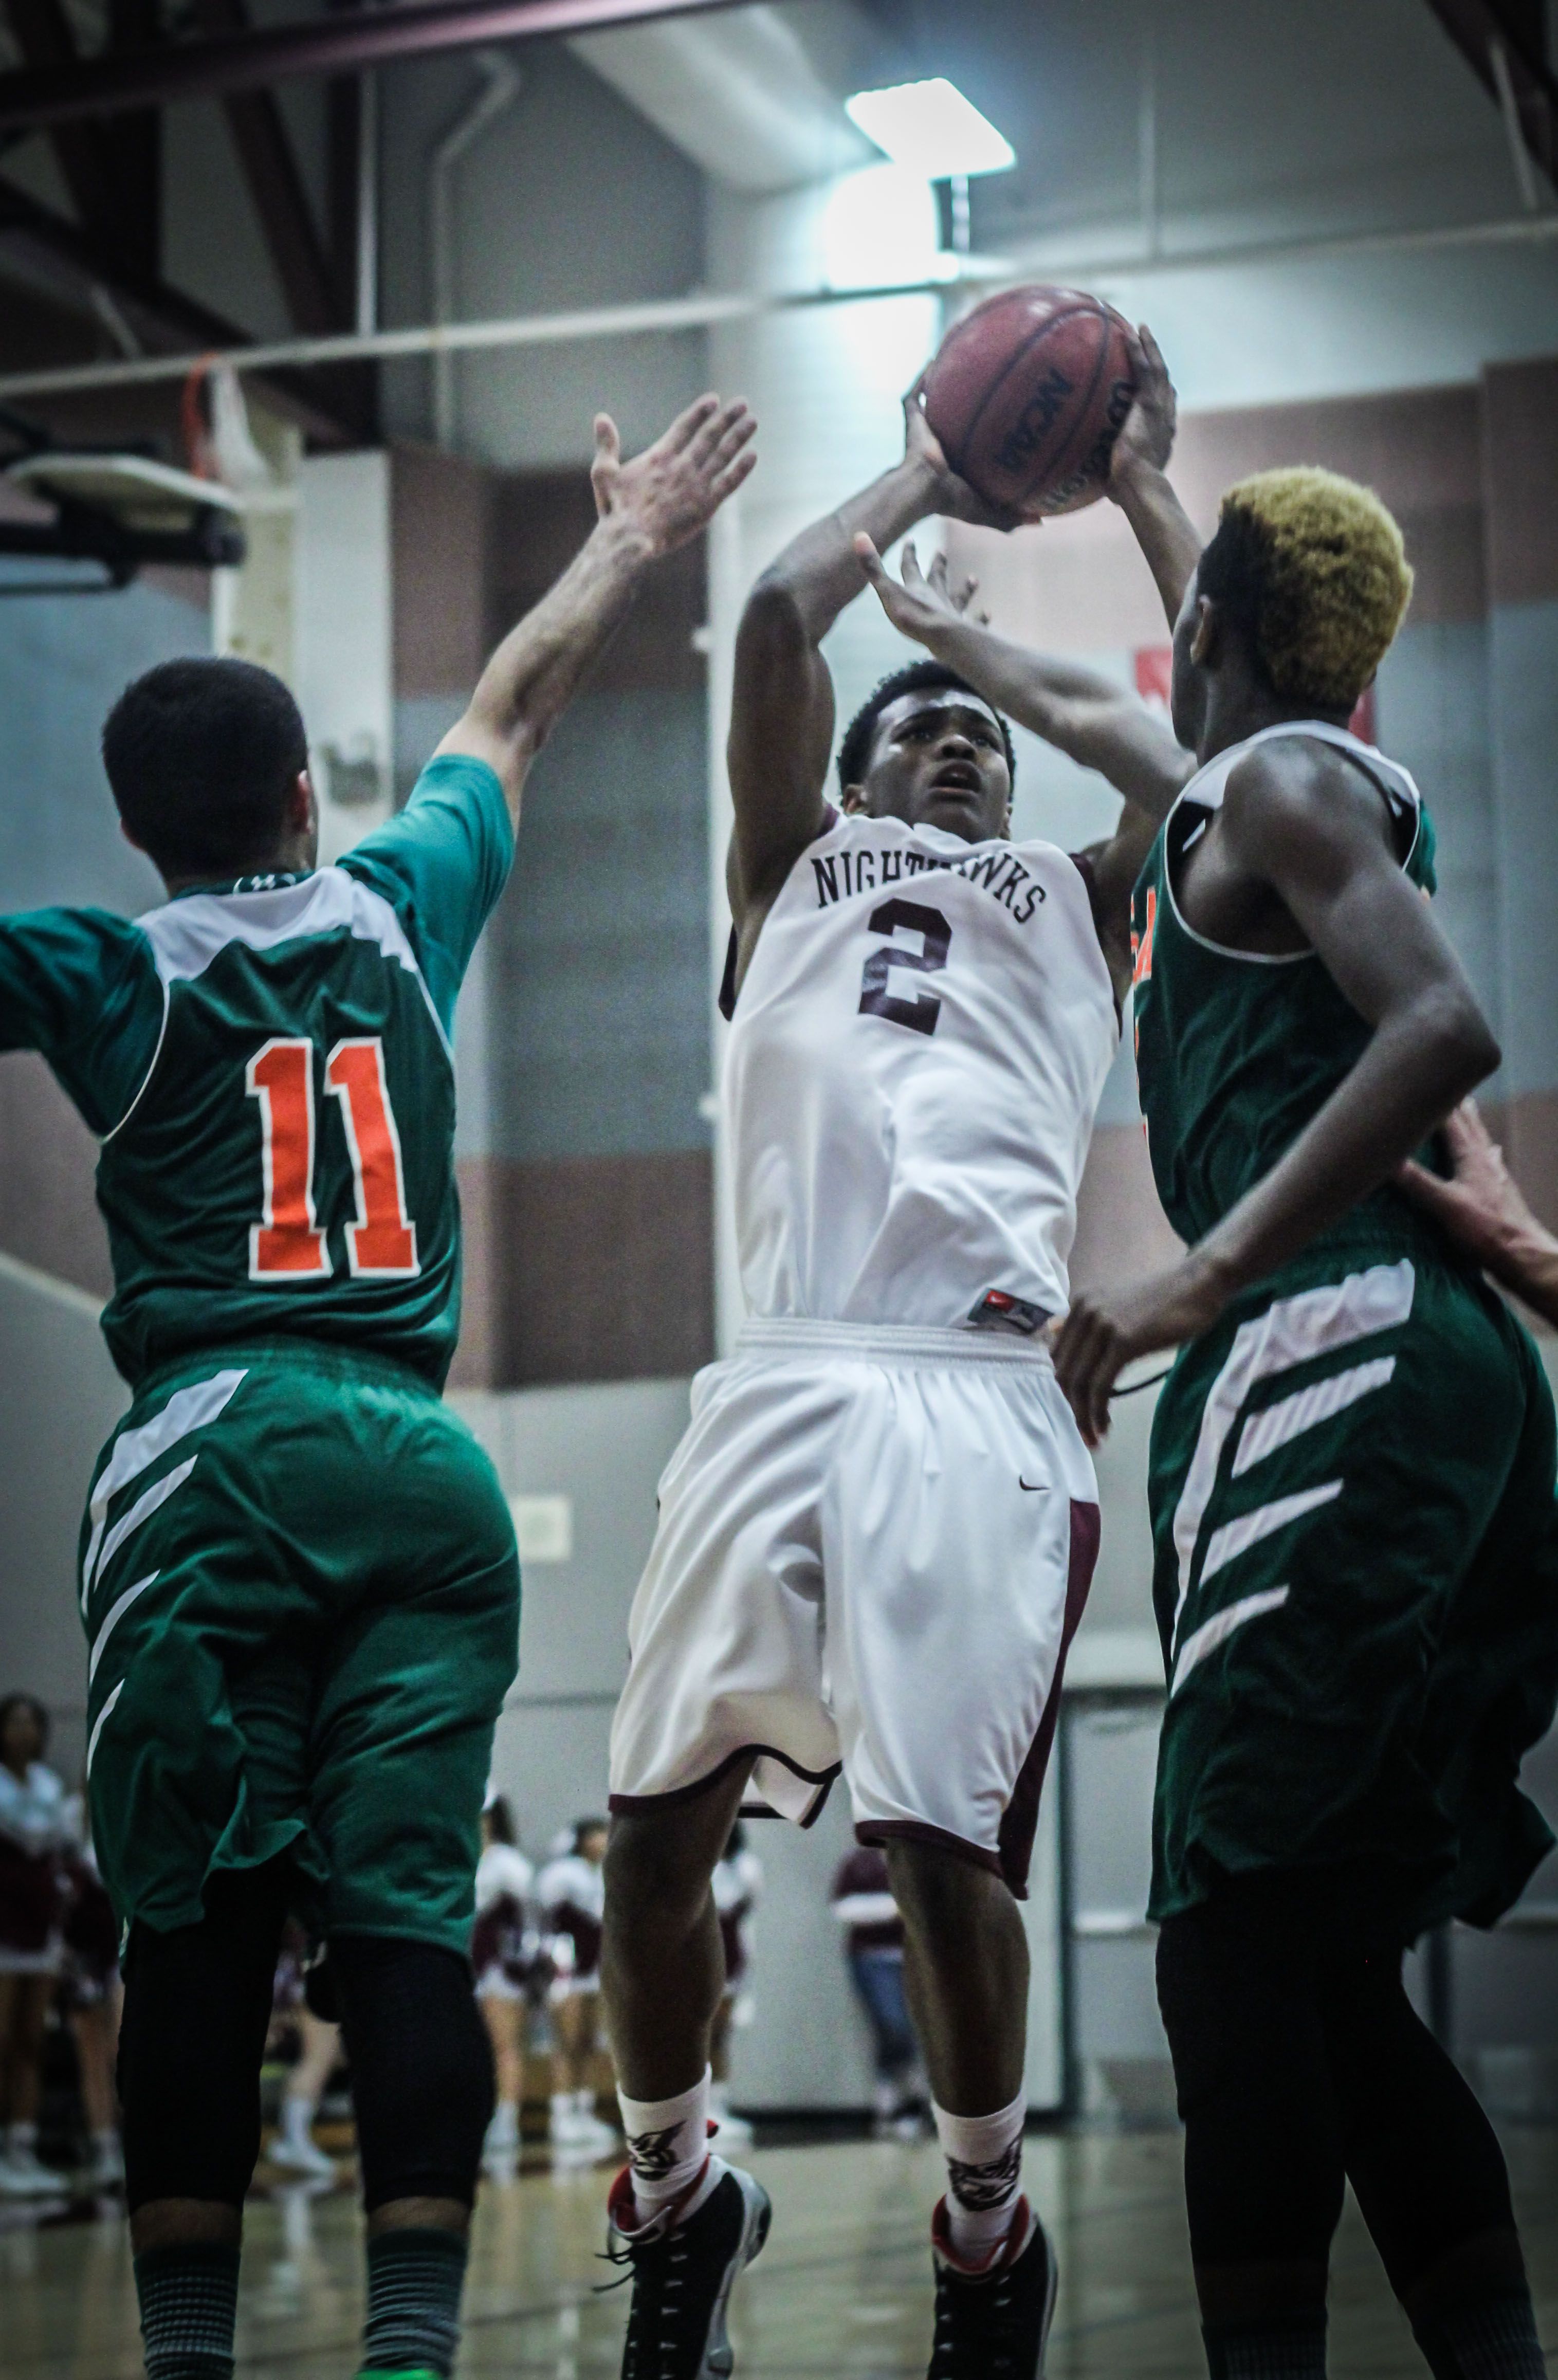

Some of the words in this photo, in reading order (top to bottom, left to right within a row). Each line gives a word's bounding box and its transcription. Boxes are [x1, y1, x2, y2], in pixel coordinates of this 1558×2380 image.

[810, 850, 1047, 923] NIGHTWKS
[857, 898, 952, 1036] 2
[245, 1036, 421, 1281] 11
